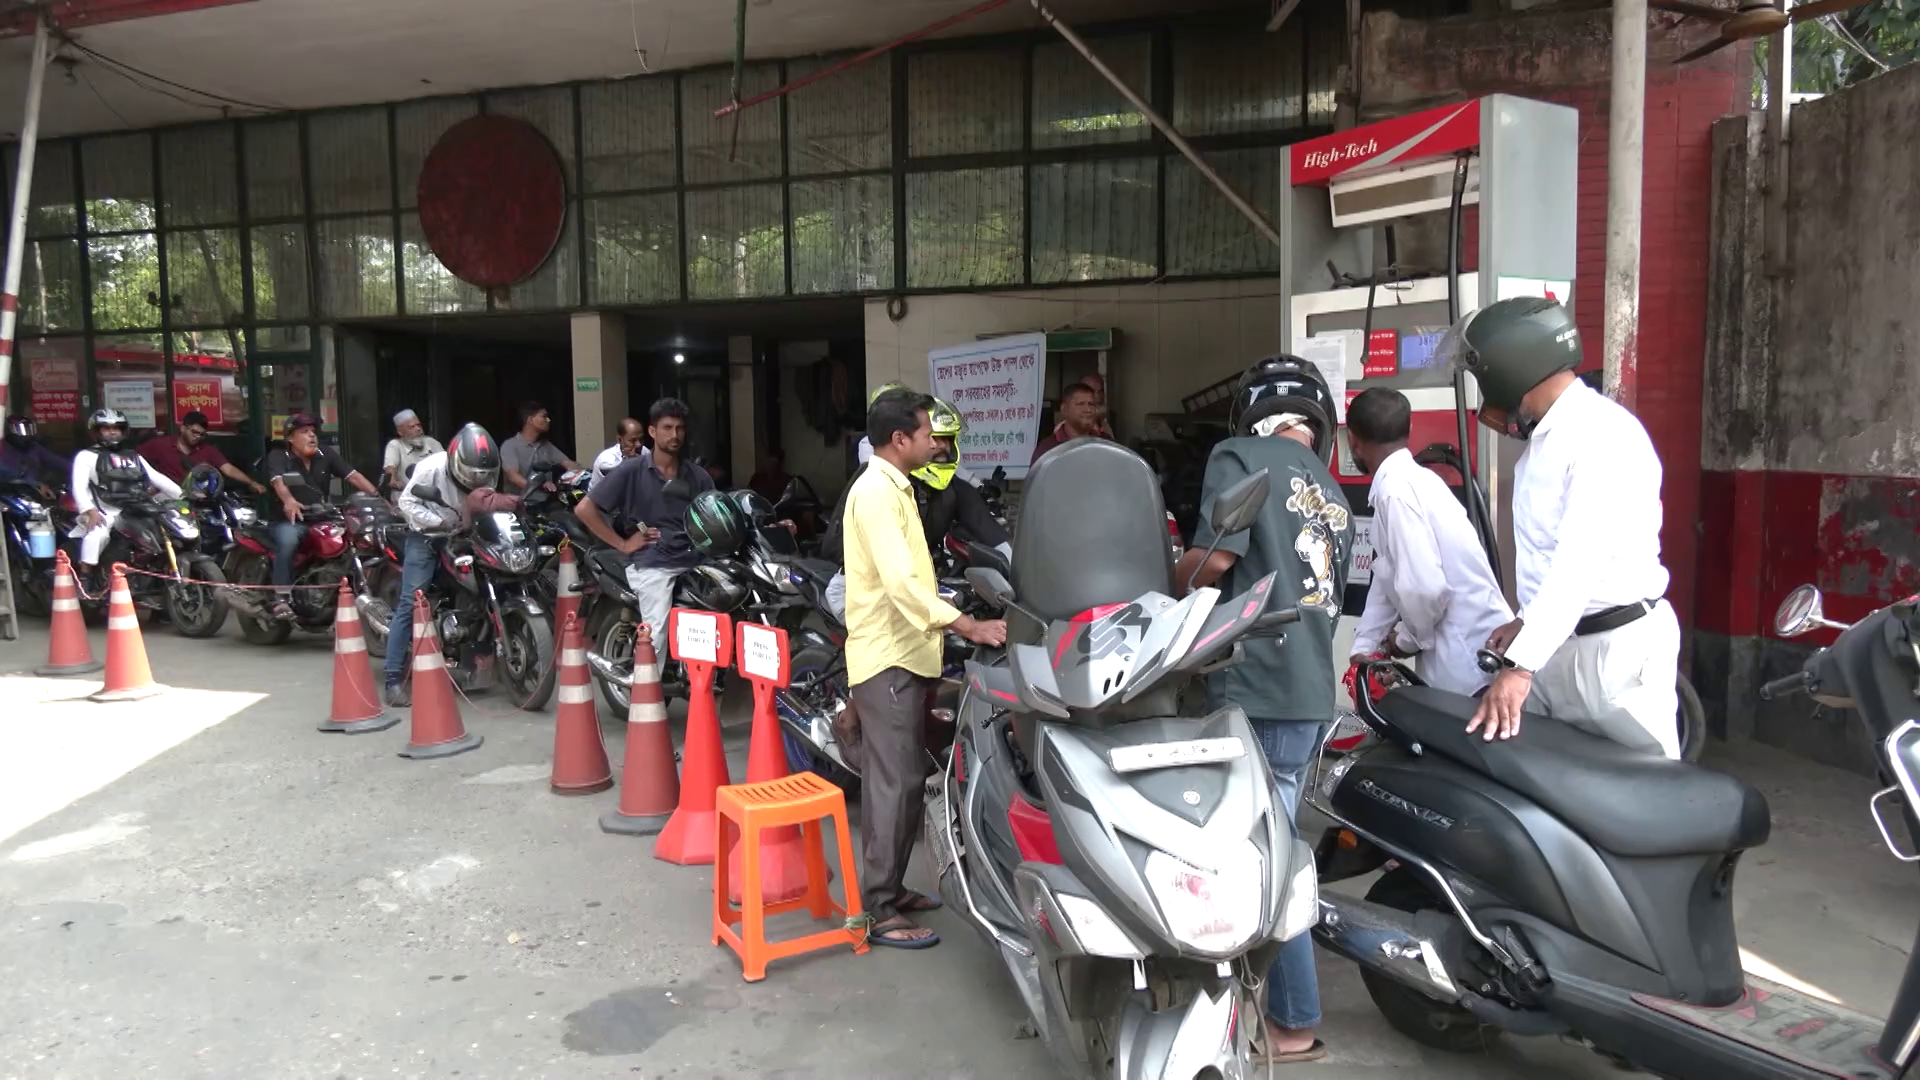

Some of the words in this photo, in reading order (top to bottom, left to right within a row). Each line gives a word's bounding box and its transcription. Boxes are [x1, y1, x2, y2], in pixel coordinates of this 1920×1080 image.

[1303, 138, 1378, 169] High-Tech
[186, 383, 211, 394] ক্যাশ
[176, 395, 218, 408] কাউন্টার
